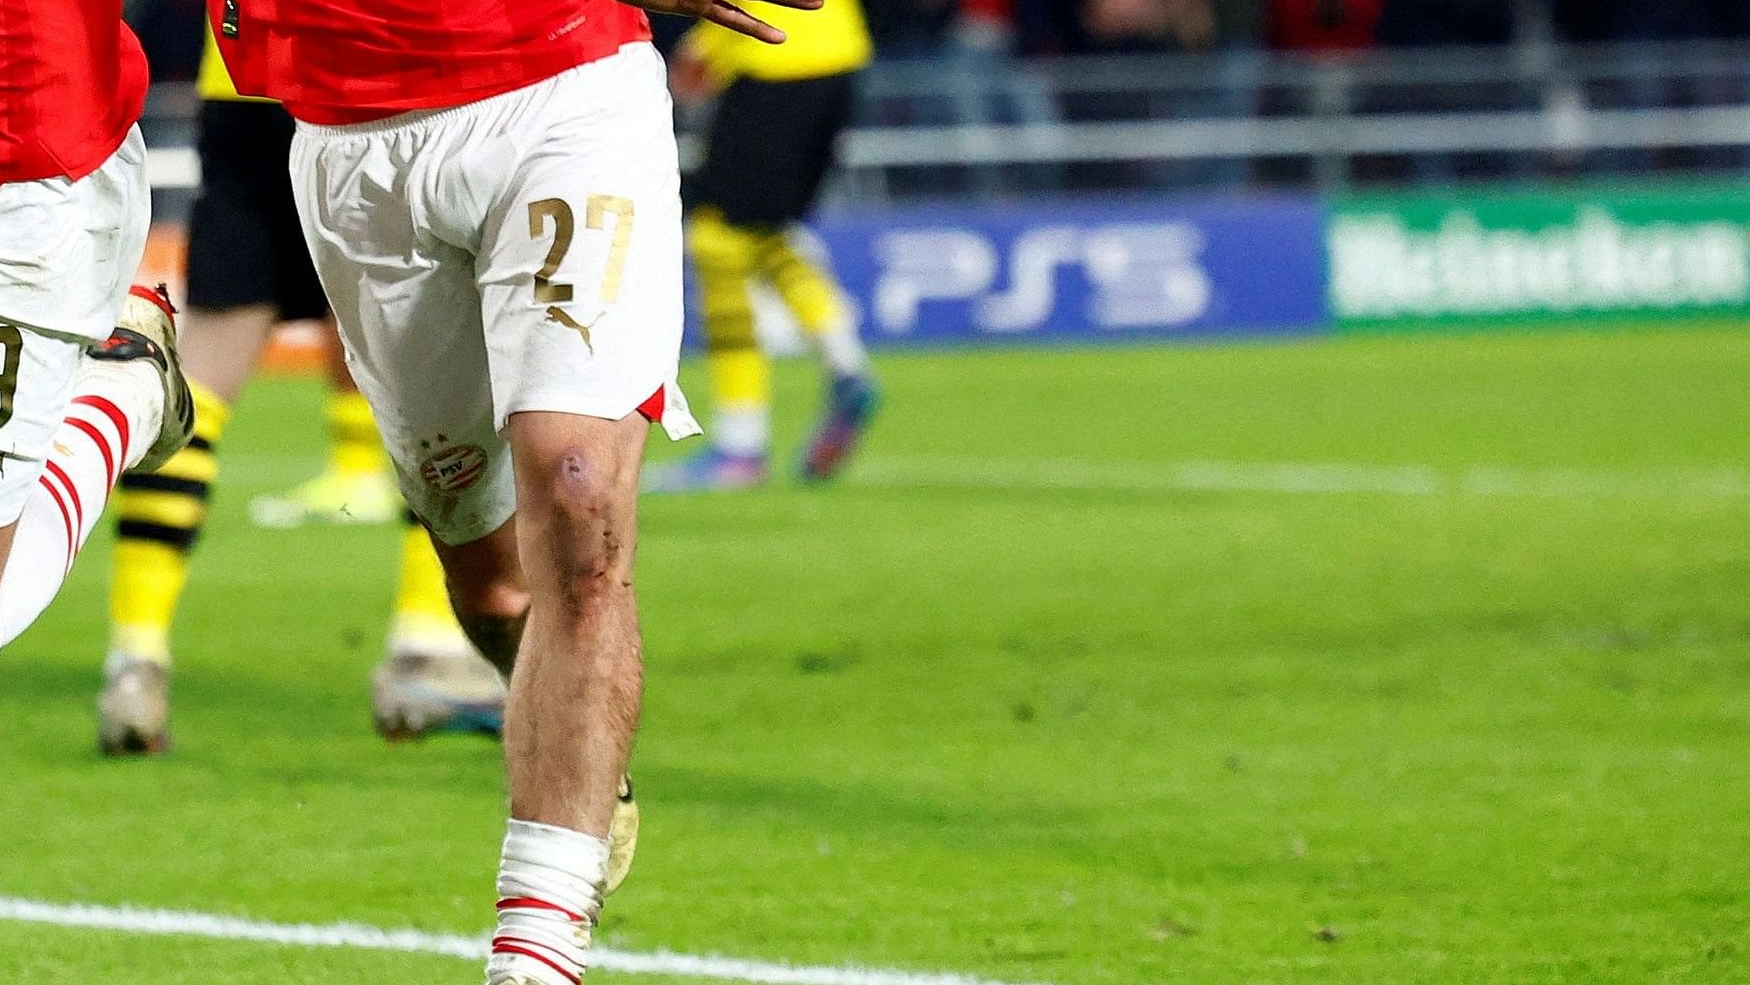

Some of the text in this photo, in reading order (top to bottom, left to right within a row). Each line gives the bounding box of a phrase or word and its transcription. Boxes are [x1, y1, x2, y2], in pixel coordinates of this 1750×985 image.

[528, 193, 635, 304] 27
[872, 220, 1210, 333] PS5
[1328, 203, 1748, 315] Heineken
